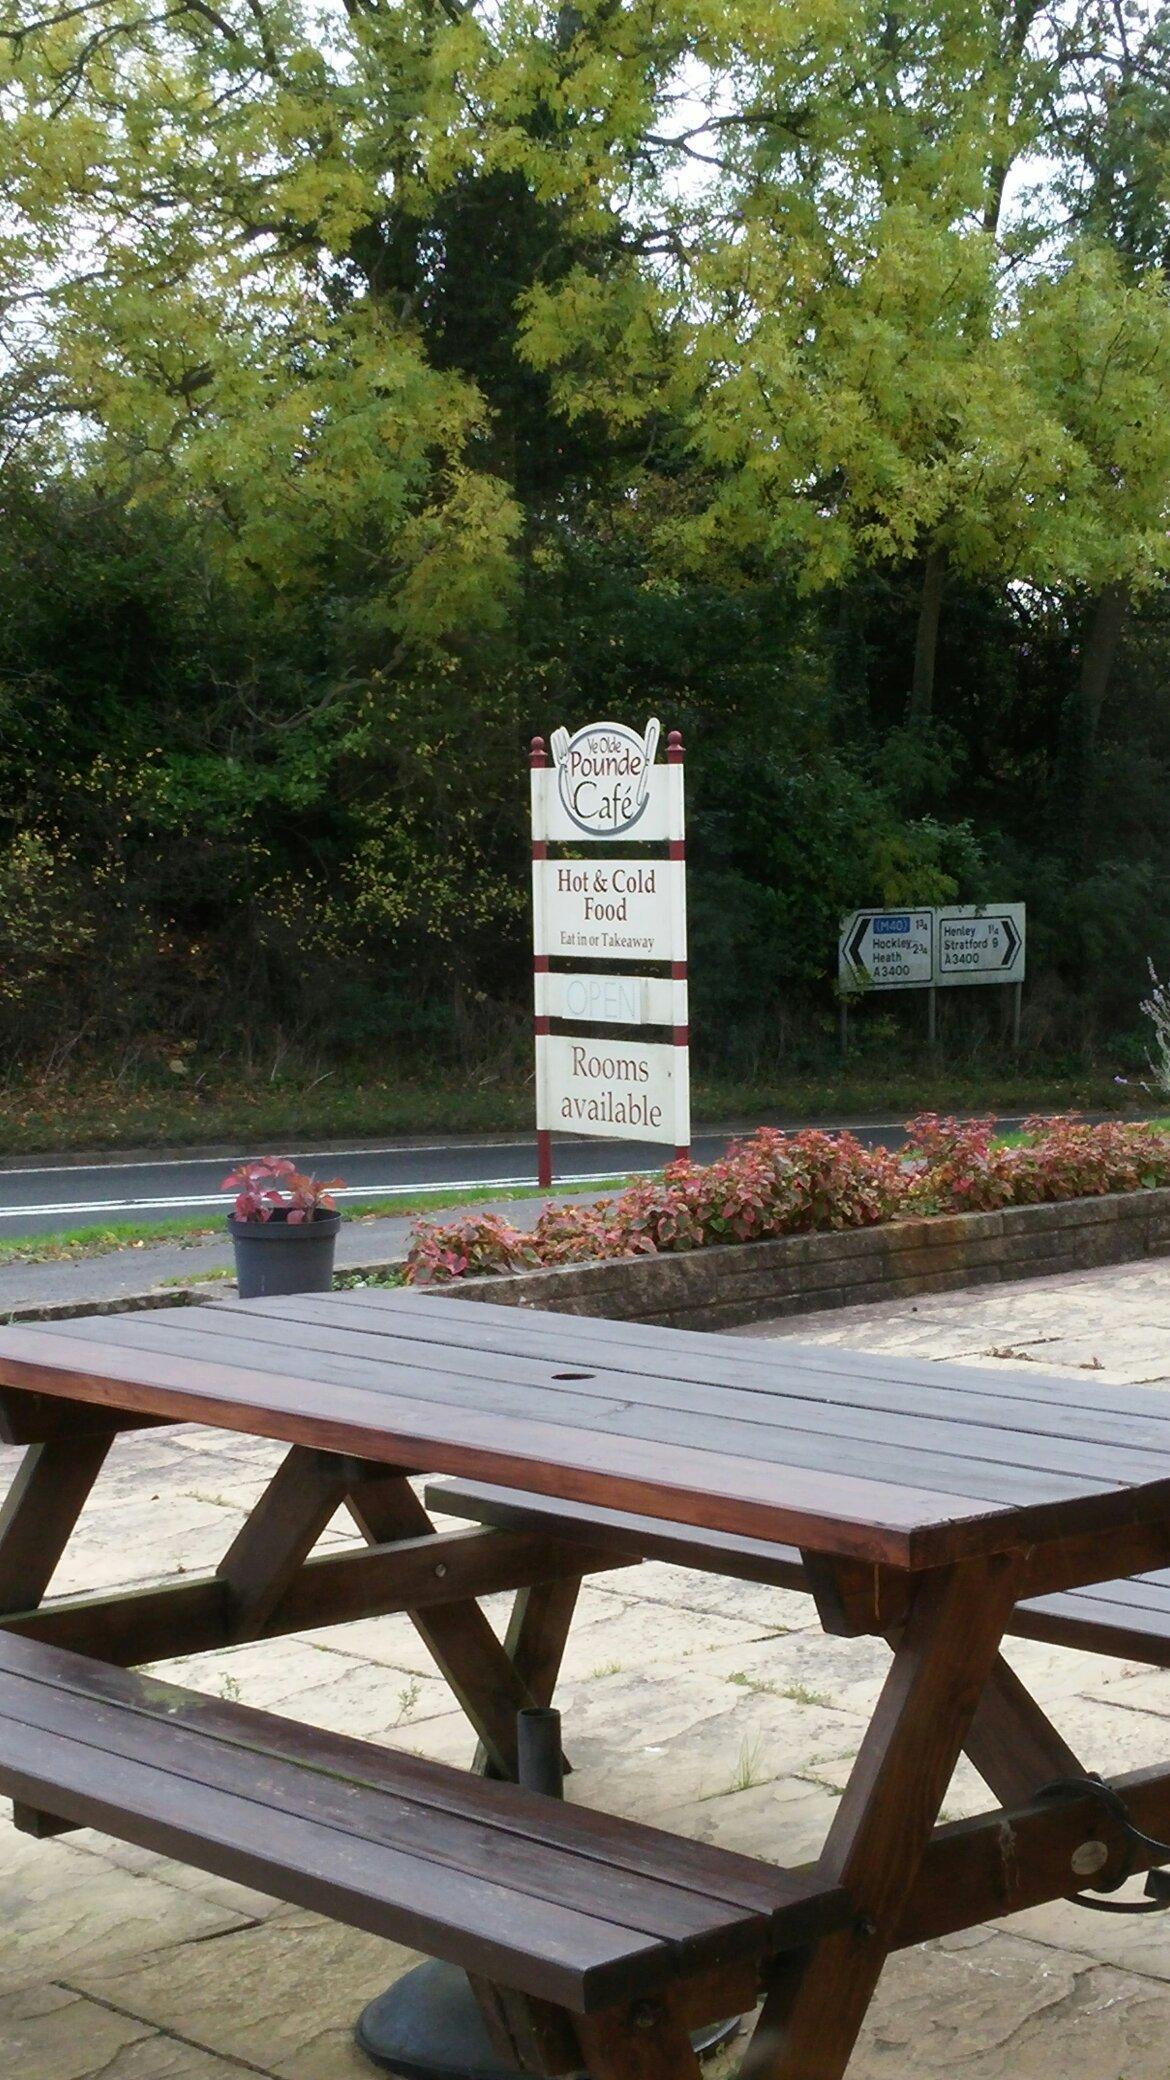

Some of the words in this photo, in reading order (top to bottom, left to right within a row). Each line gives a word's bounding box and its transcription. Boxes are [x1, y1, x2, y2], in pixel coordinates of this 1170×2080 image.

[587, 738, 598, 754] Ye
[600, 737, 621, 754] Olde
[569, 748, 641, 777] Pounde
[573, 781, 634, 827] Café
[557, 869, 589, 892] Hot
[593, 869, 608, 893] &
[612, 869, 656, 894] Cold
[584, 897, 627, 921] Food
[560, 931, 576, 945] Eat
[577, 931, 587, 946] in
[589, 935, 598, 946] or
[601, 932, 656, 953] Takeaway
[944, 926, 976, 938] Henley
[873, 938, 912, 950] Hockley
[944, 939, 988, 950] Stratford
[992, 937, 999, 948] 9
[873, 952, 902, 963] Heath
[944, 952, 979, 965] A3400
[873, 965, 910, 977] A3400
[567, 980, 635, 1018] OPEN
[571, 1046, 649, 1082] Rooms
[561, 1091, 662, 1127] available
